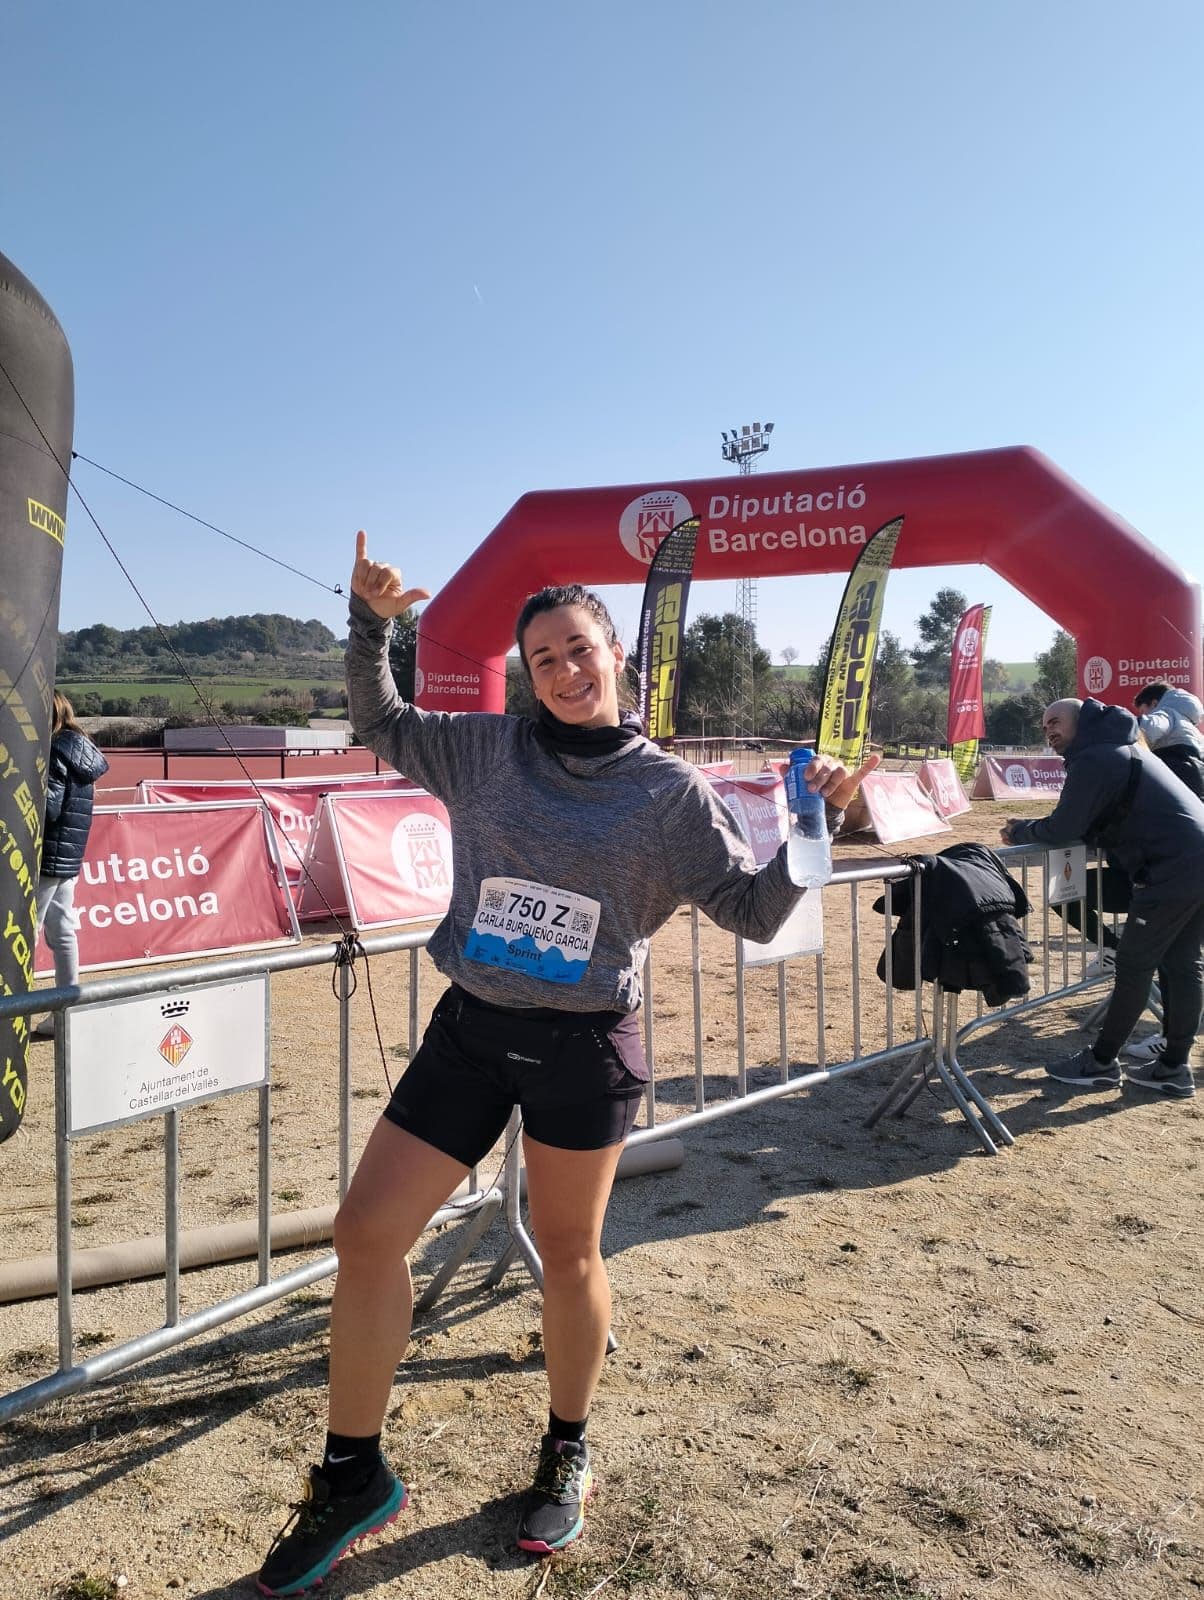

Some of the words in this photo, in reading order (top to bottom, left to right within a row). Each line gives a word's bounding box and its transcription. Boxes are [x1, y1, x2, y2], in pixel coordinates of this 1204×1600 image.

[708, 483, 866, 523] Diputació
[708, 523, 867, 553] Barcelona
[1118, 656, 1190, 673] Diputació
[427, 672, 480, 684] Diputació
[427, 684, 480, 695] Barcelona
[1118, 673, 1190, 686] Barcelona
[1032, 769, 1067, 780] Diputa
[82, 846, 210, 885] utació
[72, 891, 219, 929] rcelona
[507, 892, 546, 922] 750
[550, 904, 570, 928] Z
[478, 911, 504, 928] CARLA
[505, 918, 553, 943] BURGUEÑO
[555, 932, 589, 953] GARCIA
[507, 944, 542, 961] Sprint
[140, 1070, 195, 1093] Ajuntament
[196, 1067, 209, 1077] de
[129, 1089, 174, 1110] Castellar
[175, 1083, 190, 1096] del
